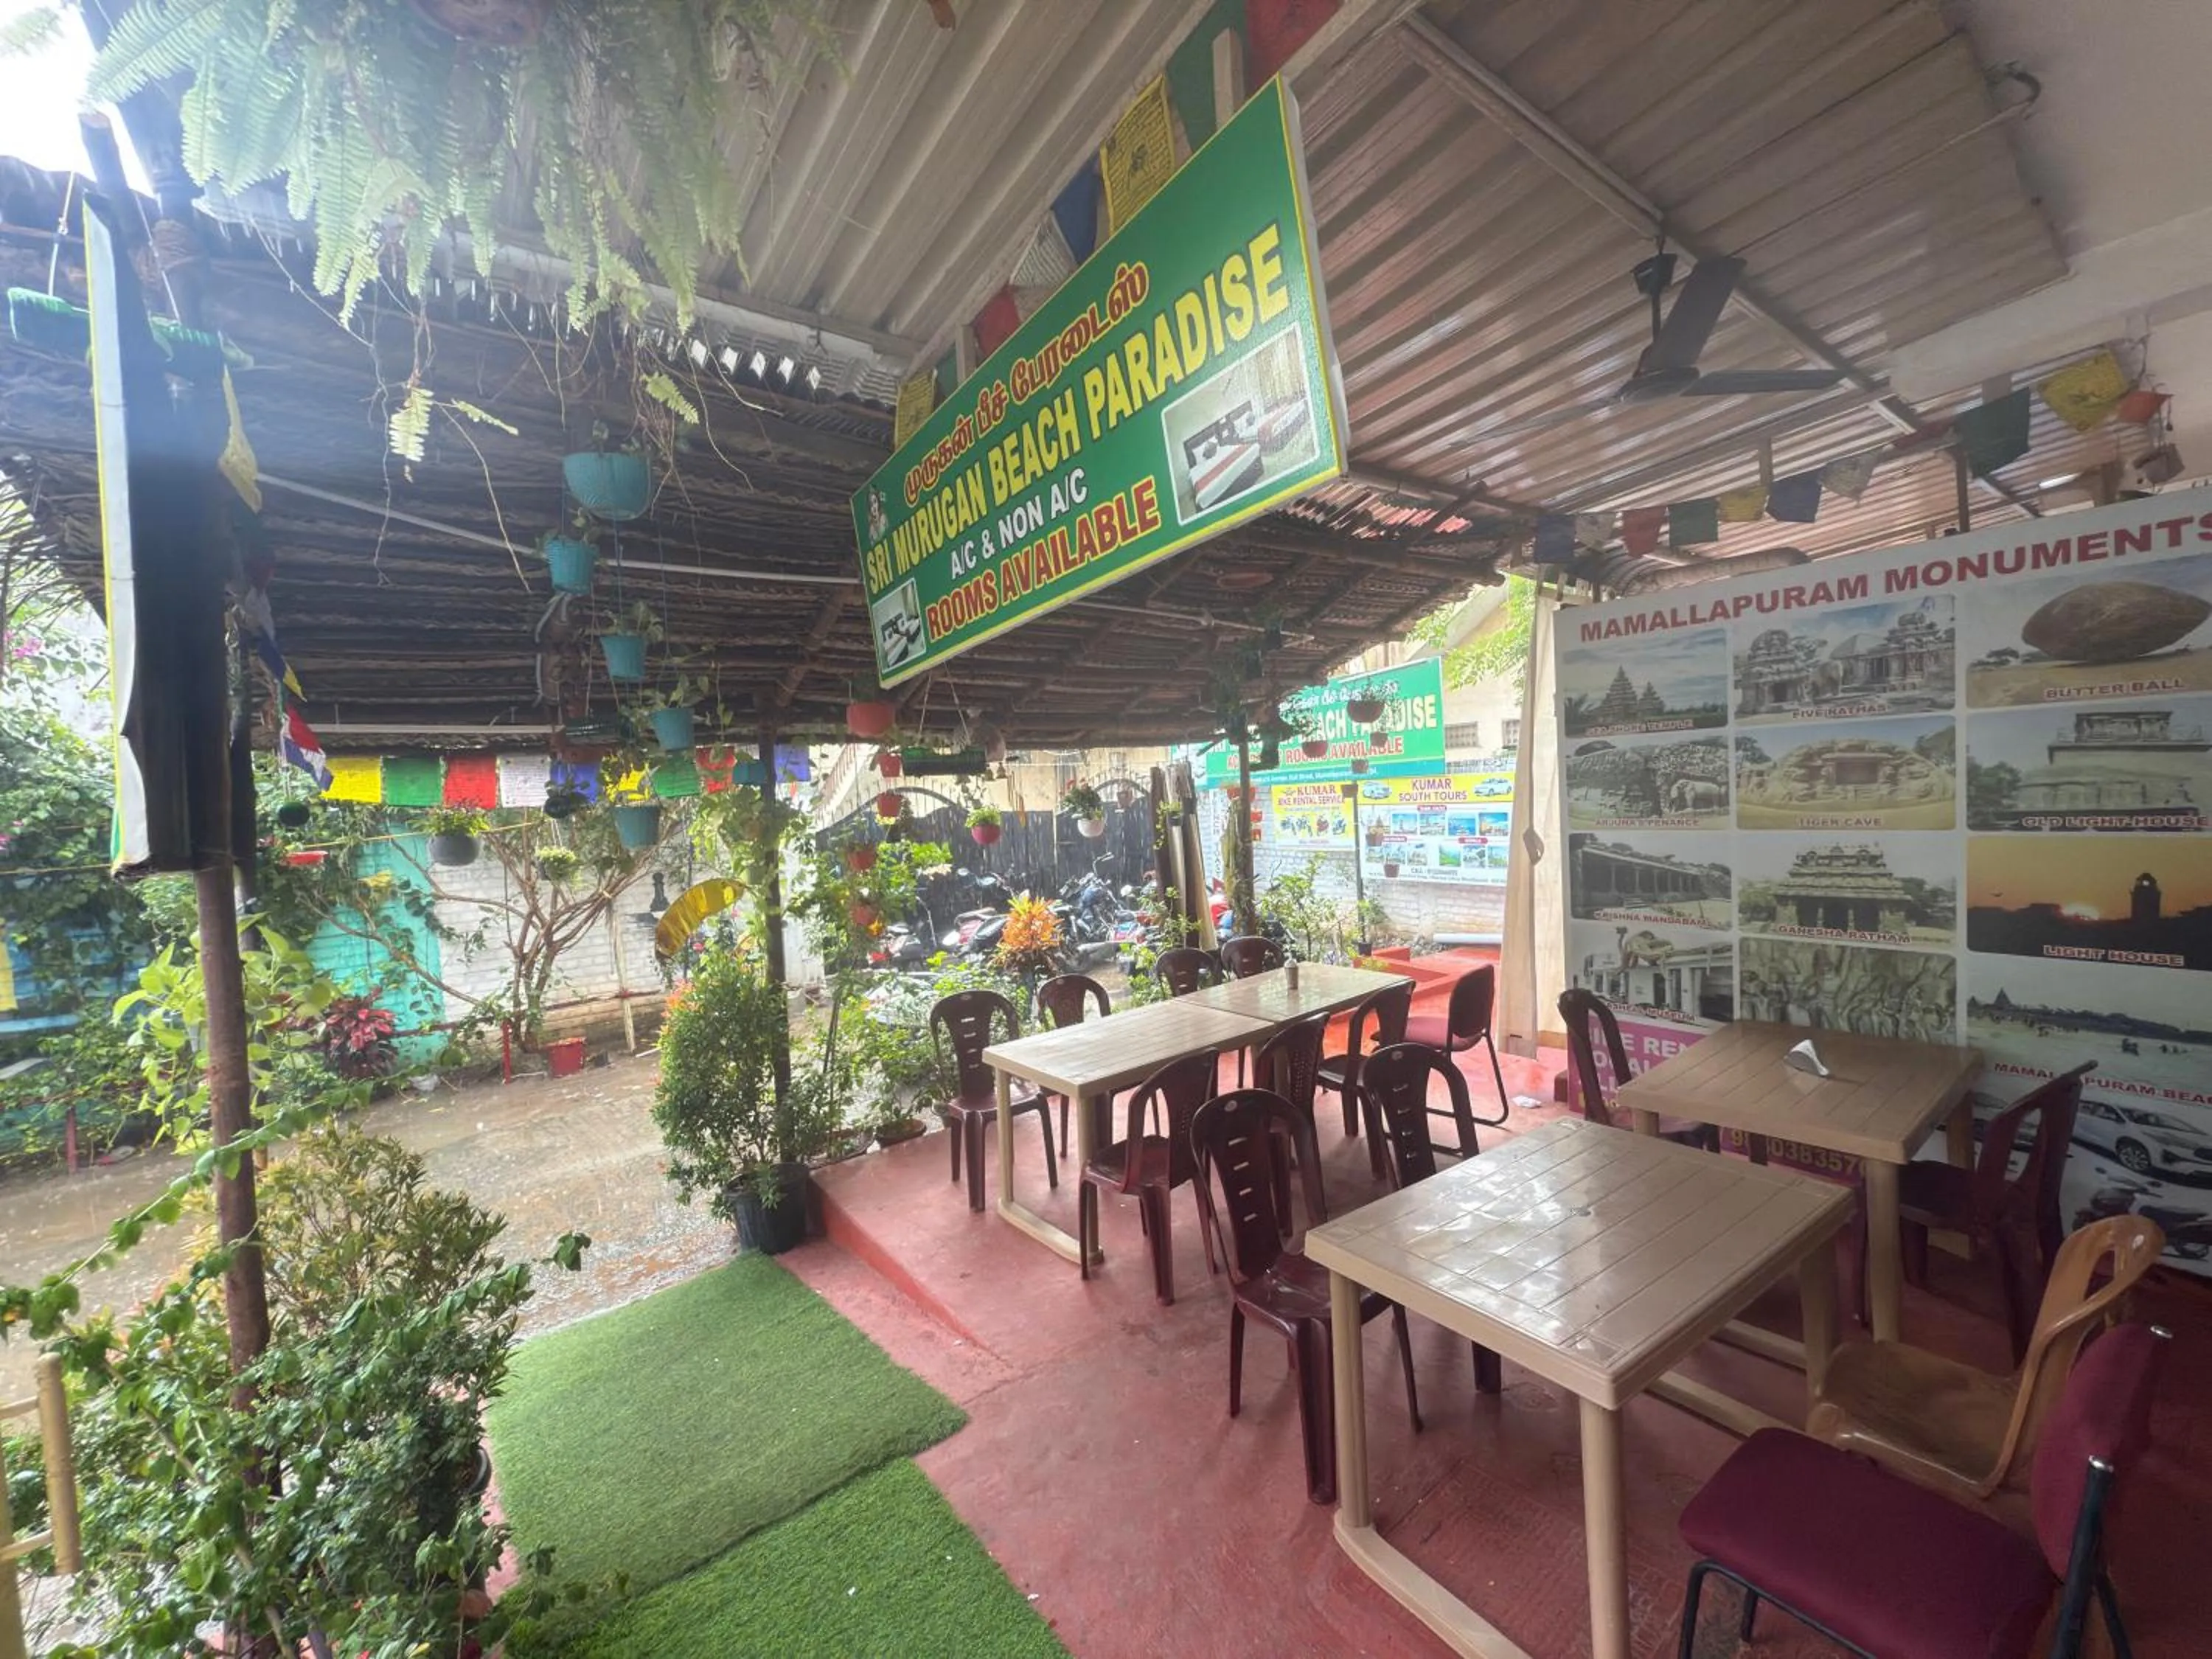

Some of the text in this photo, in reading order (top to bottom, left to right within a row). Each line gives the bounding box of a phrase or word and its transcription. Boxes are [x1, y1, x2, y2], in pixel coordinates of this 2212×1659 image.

[867, 223, 1289, 594] SRI MURUGAN BEACH PARADISE
[951, 468, 1088, 579] A/C & NON A/C
[926, 475, 1161, 642] ROOMS AVAILABLE
[1581, 574, 1868, 642] MAMALLAPURAM
[2045, 678, 2185, 698] BUTTER BALL
[1298, 785, 1336, 795] KUMAR
[1412, 779, 1451, 790] KUMAR
[1399, 790, 1467, 801] SOUTH TOURS
[1844, 818, 1882, 827] CAVE
[2134, 815, 2208, 827] HOUSE
[1848, 930, 1911, 944] RATHAM
[2044, 945, 2185, 967] LIGHT HOUSE
